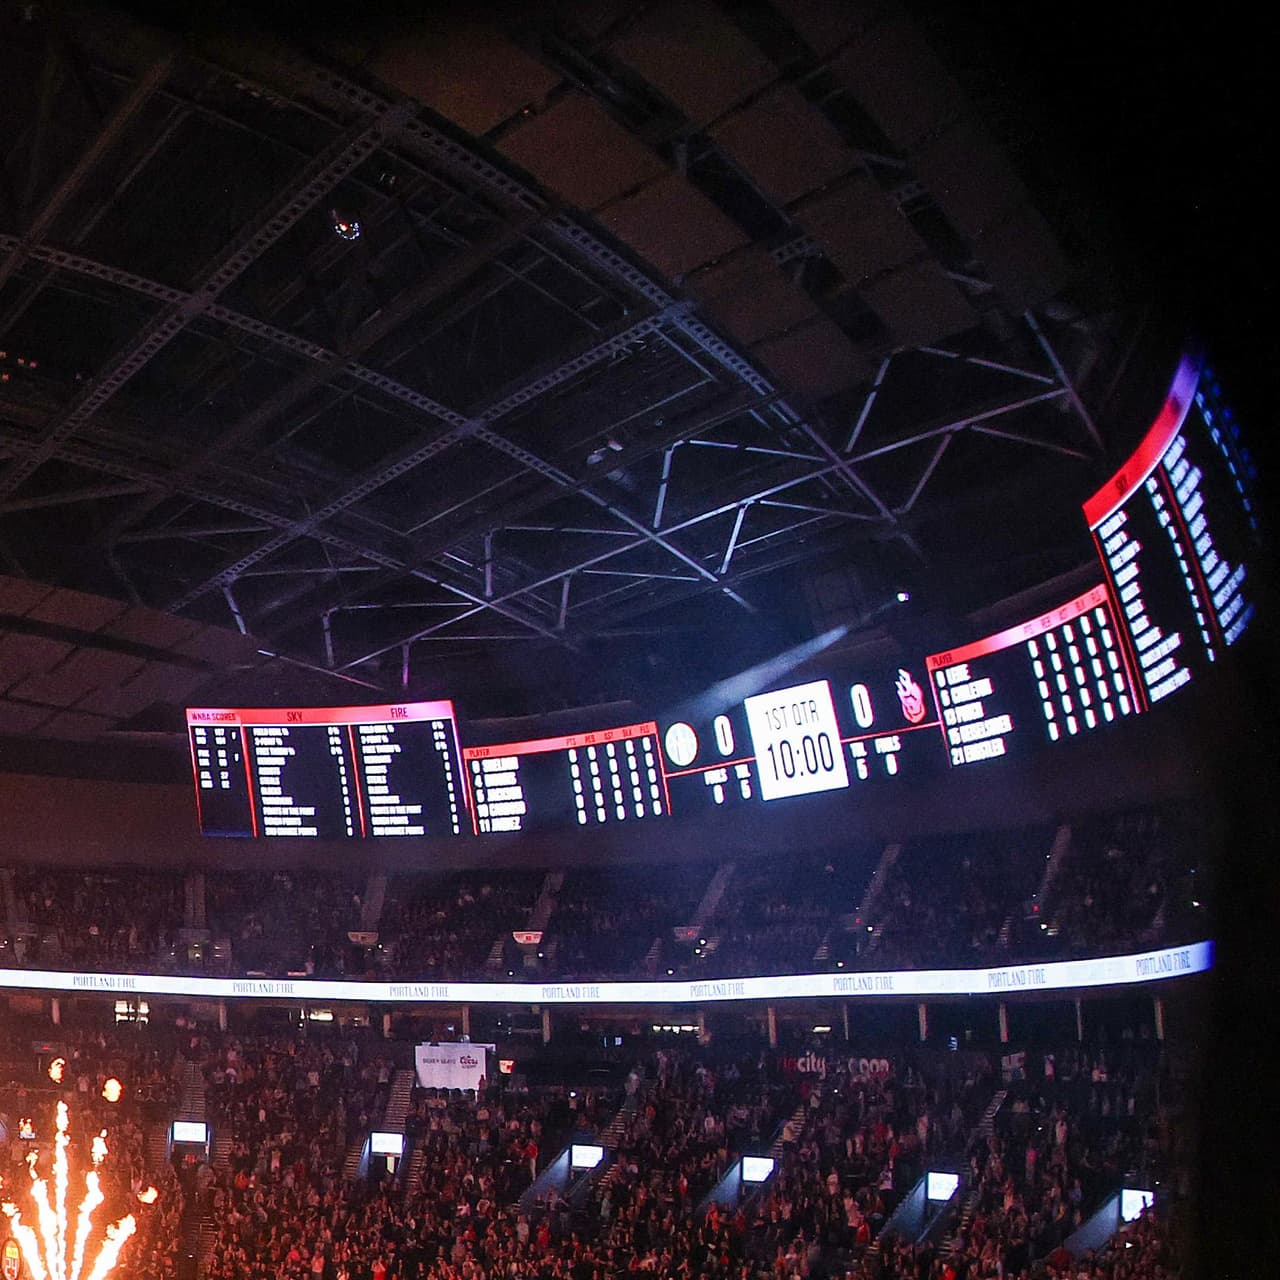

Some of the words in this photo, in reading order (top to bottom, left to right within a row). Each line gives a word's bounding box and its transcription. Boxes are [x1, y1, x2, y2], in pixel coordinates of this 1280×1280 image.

[391, 708, 409, 719] FIRE
[850, 683, 874, 729] 0
[287, 711, 303, 722] SKY
[765, 706, 788, 731] 1ST
[792, 700, 819, 726] QTR
[713, 714, 735, 756] 0
[767, 732, 835, 781] 10:00
[1136, 956, 1172, 977] PORTLAND
[1173, 950, 1191, 972] FIRE
[72, 975, 113, 987] PORTLAND
[114, 977, 134, 989] FIRE
[832, 976, 872, 992] PORTLAND
[873, 974, 893, 990] FIRE
[987, 969, 1026, 988] PORTLAND
[1027, 966, 1046, 984] FIRE
[232, 981, 273, 994] PORTLAND
[274, 981, 294, 994] FIRE
[389, 985, 428, 998] PORTLAND
[429, 985, 448, 998] FIRE
[541, 986, 580, 999] PORTLAND
[581, 986, 600, 999] FIRE
[689, 981, 725, 998] PORTLAND
[726, 981, 744, 998] FIRE
